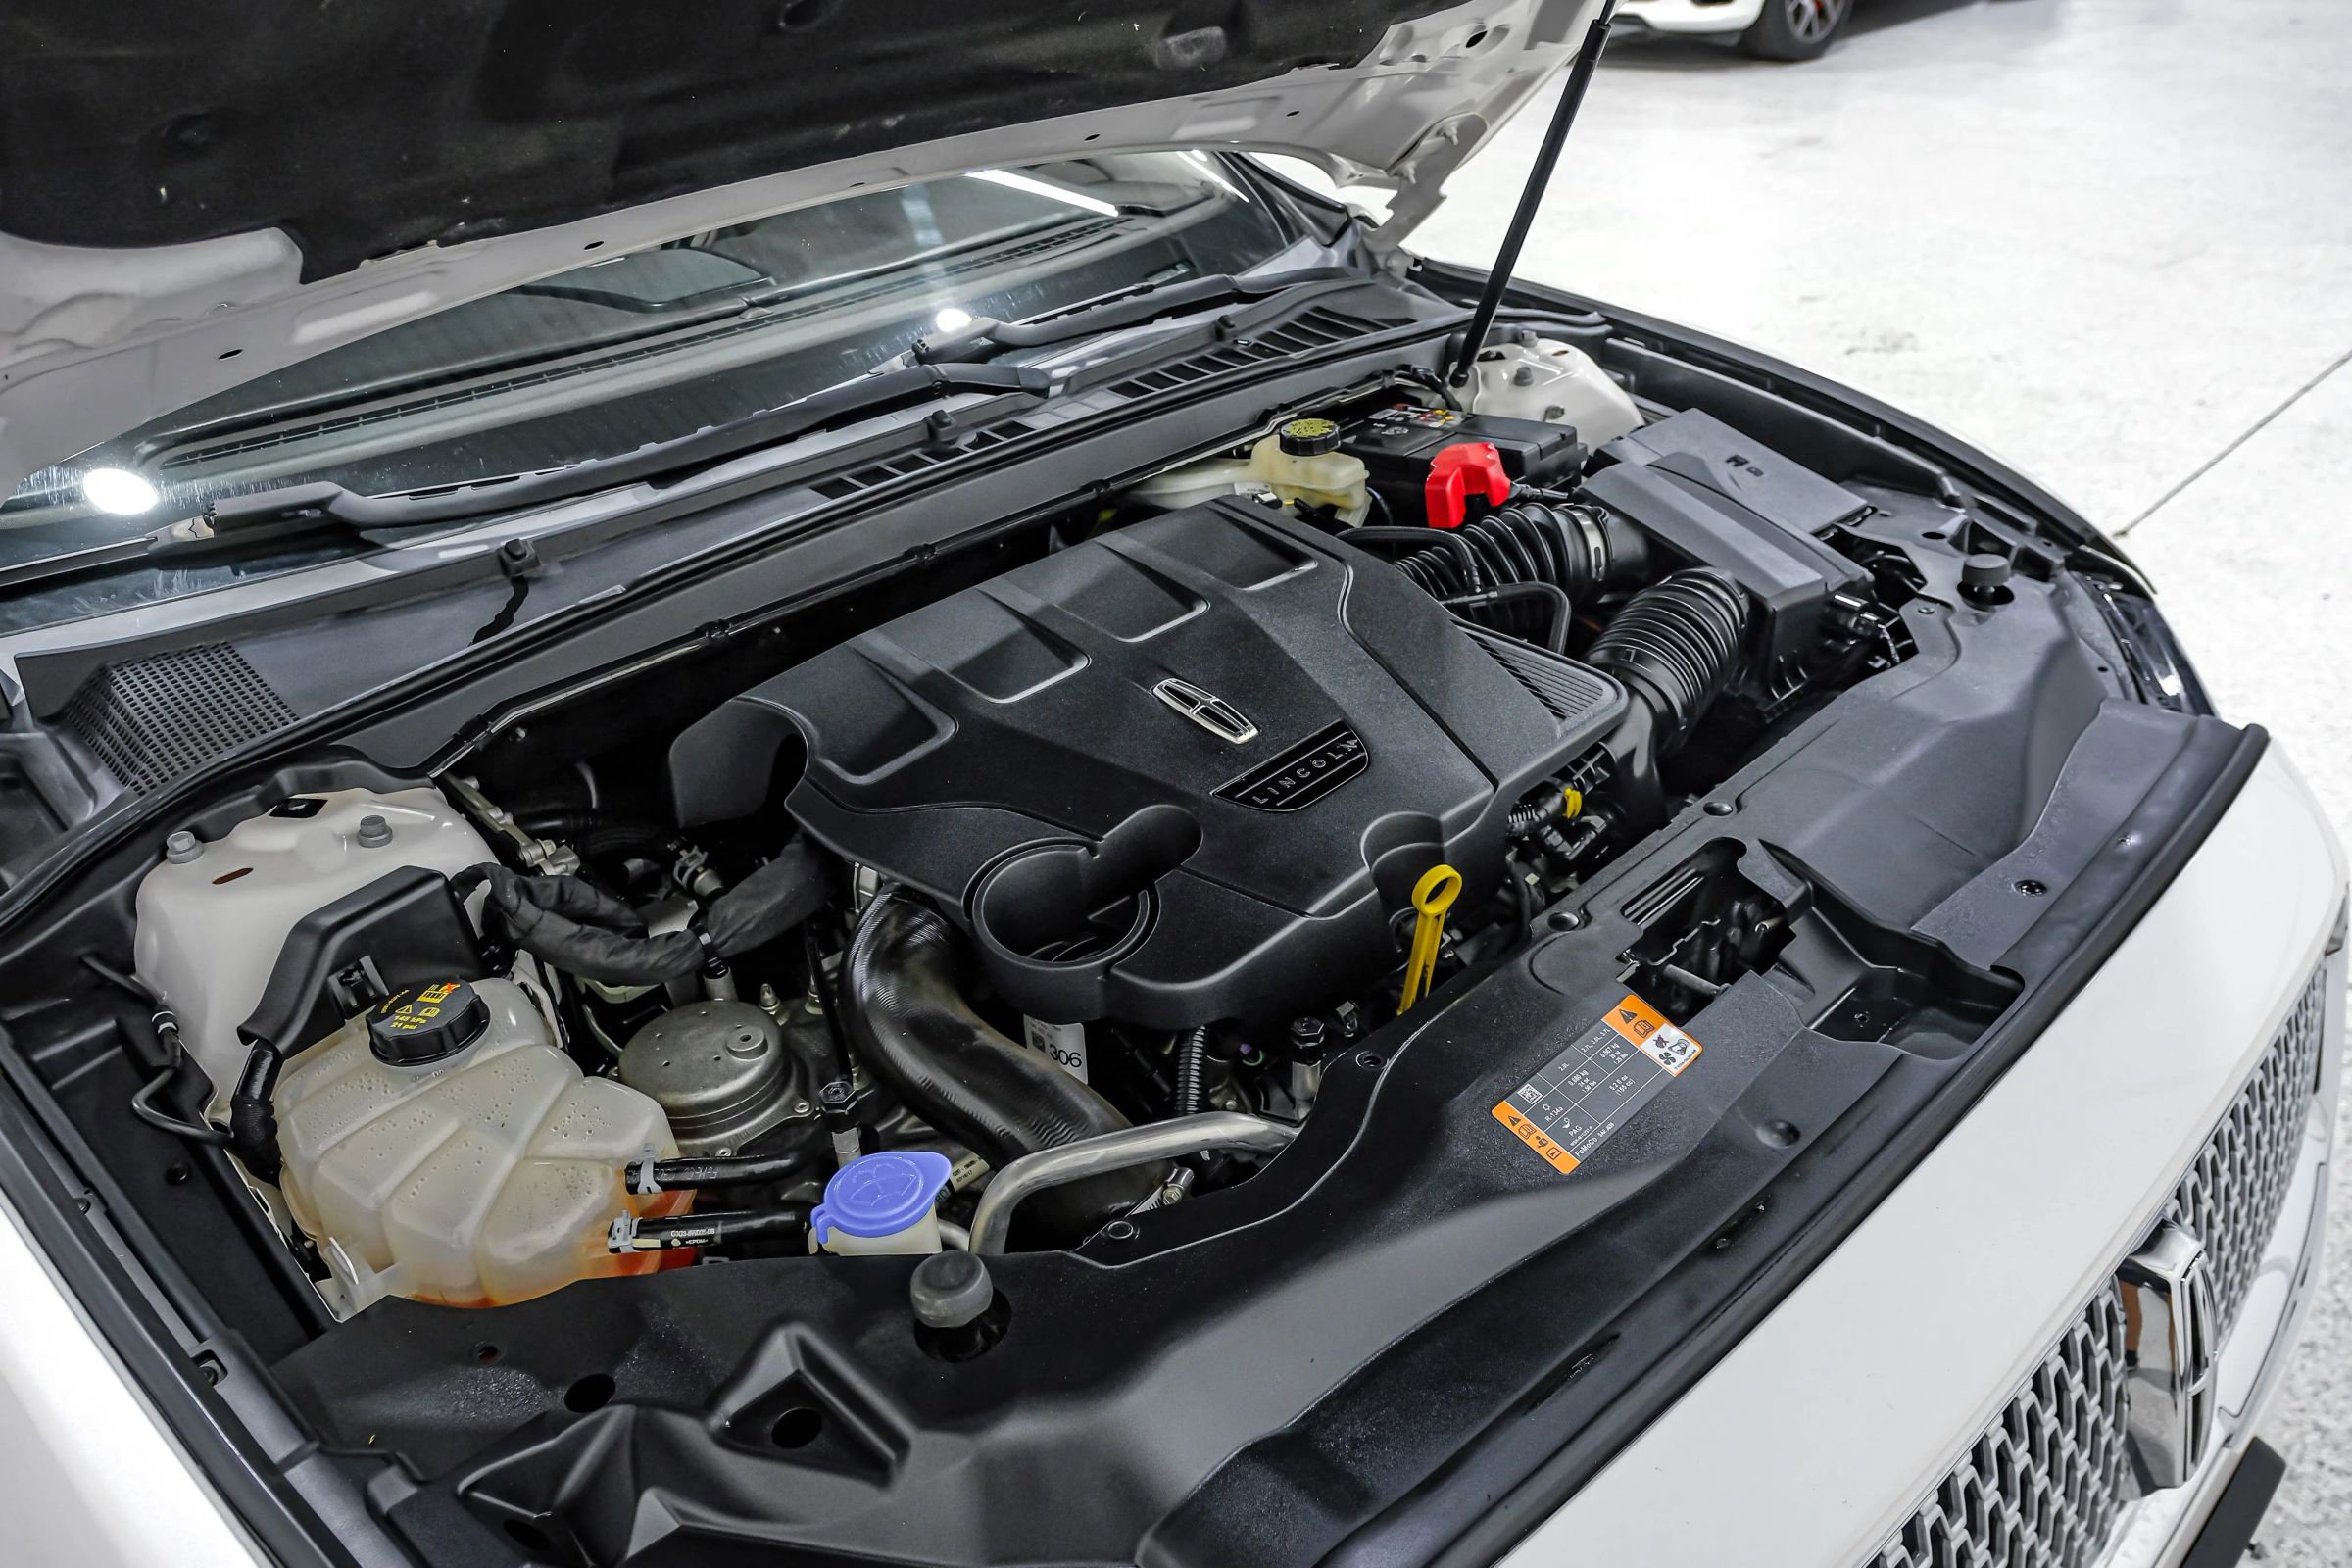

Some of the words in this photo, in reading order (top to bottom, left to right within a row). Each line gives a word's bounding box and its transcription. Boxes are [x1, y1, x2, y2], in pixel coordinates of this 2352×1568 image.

[1252, 739, 1358, 804] LINCOLN
[1050, 1044, 1082, 1068] 306
[1544, 1106, 1564, 1122] R-134a
[1568, 1125, 1583, 1137] PAG
[1574, 1137, 1598, 1157] FoMoCo
